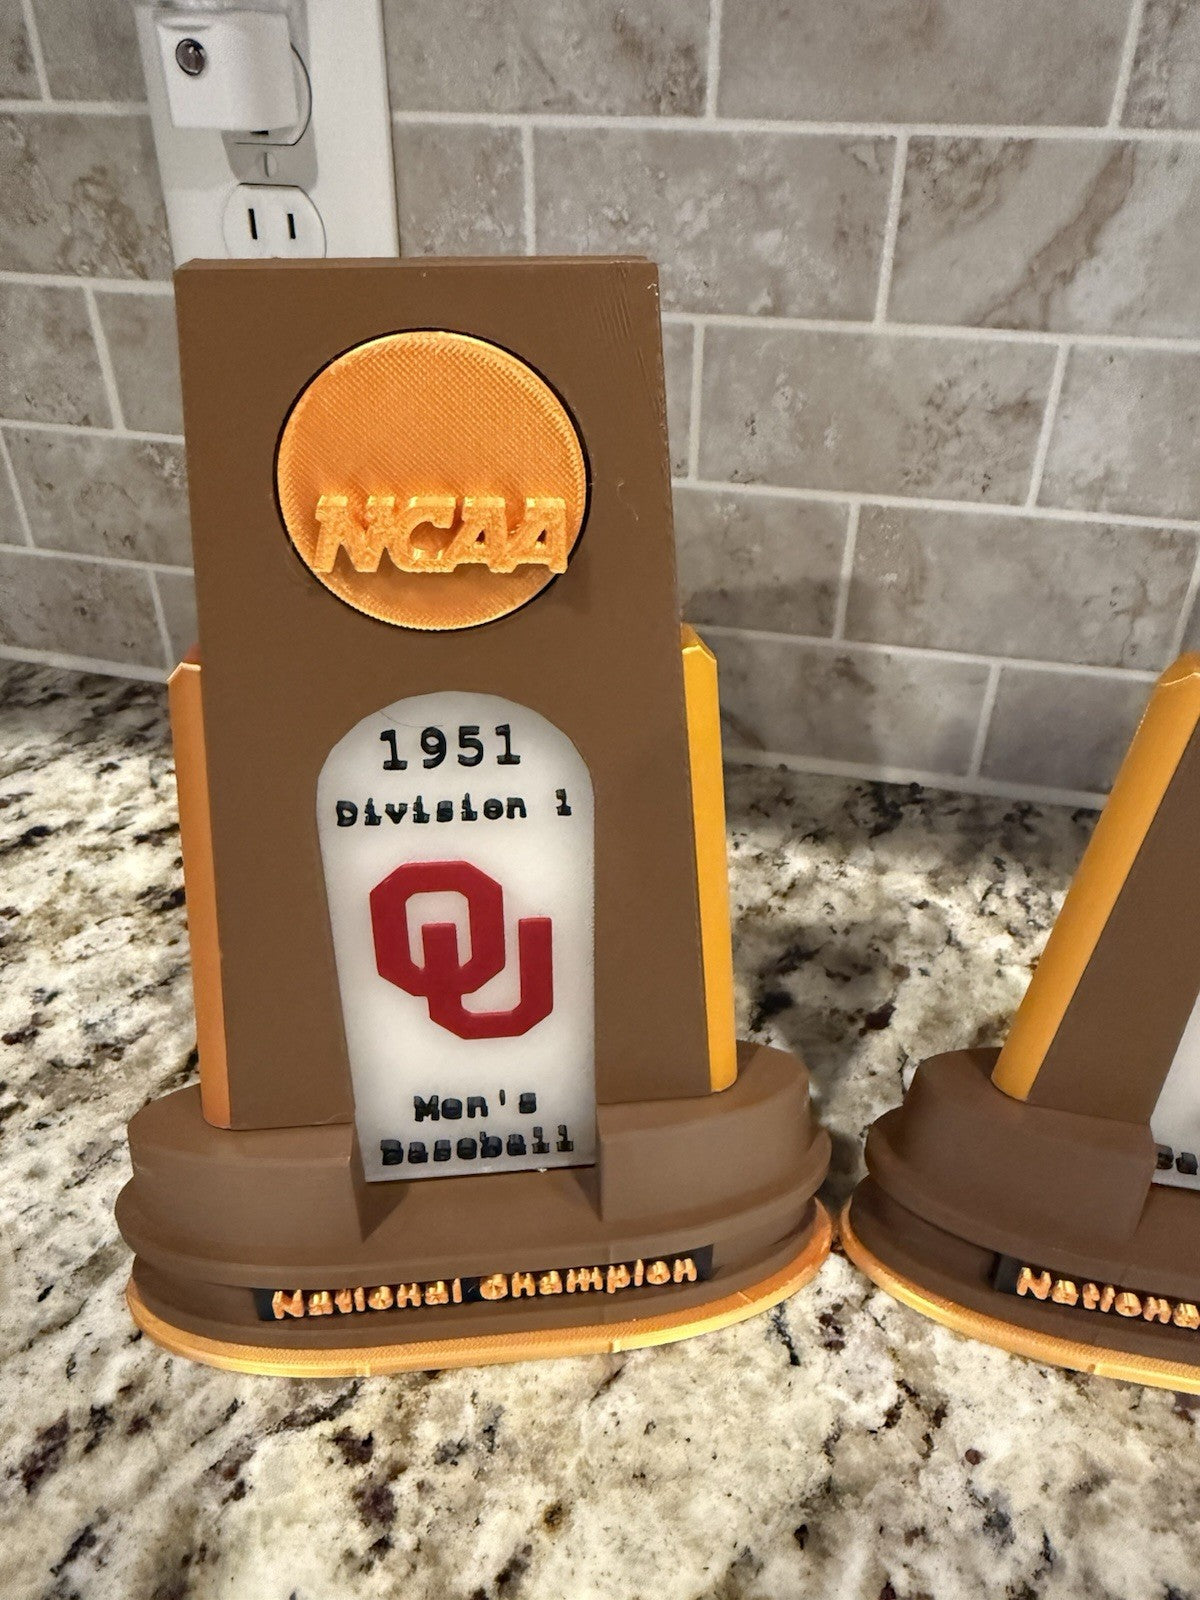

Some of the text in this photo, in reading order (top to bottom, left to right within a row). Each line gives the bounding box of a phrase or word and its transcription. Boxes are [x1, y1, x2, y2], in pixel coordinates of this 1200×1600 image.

[312, 494, 569, 574] NCAA
[379, 723, 522, 772] 1951
[335, 791, 528, 828] Division
[368, 859, 555, 1041] OU
[412, 1088, 538, 1123] Men's
[380, 1123, 575, 1167] Baseball
[271, 1257, 698, 1321] National Champion
